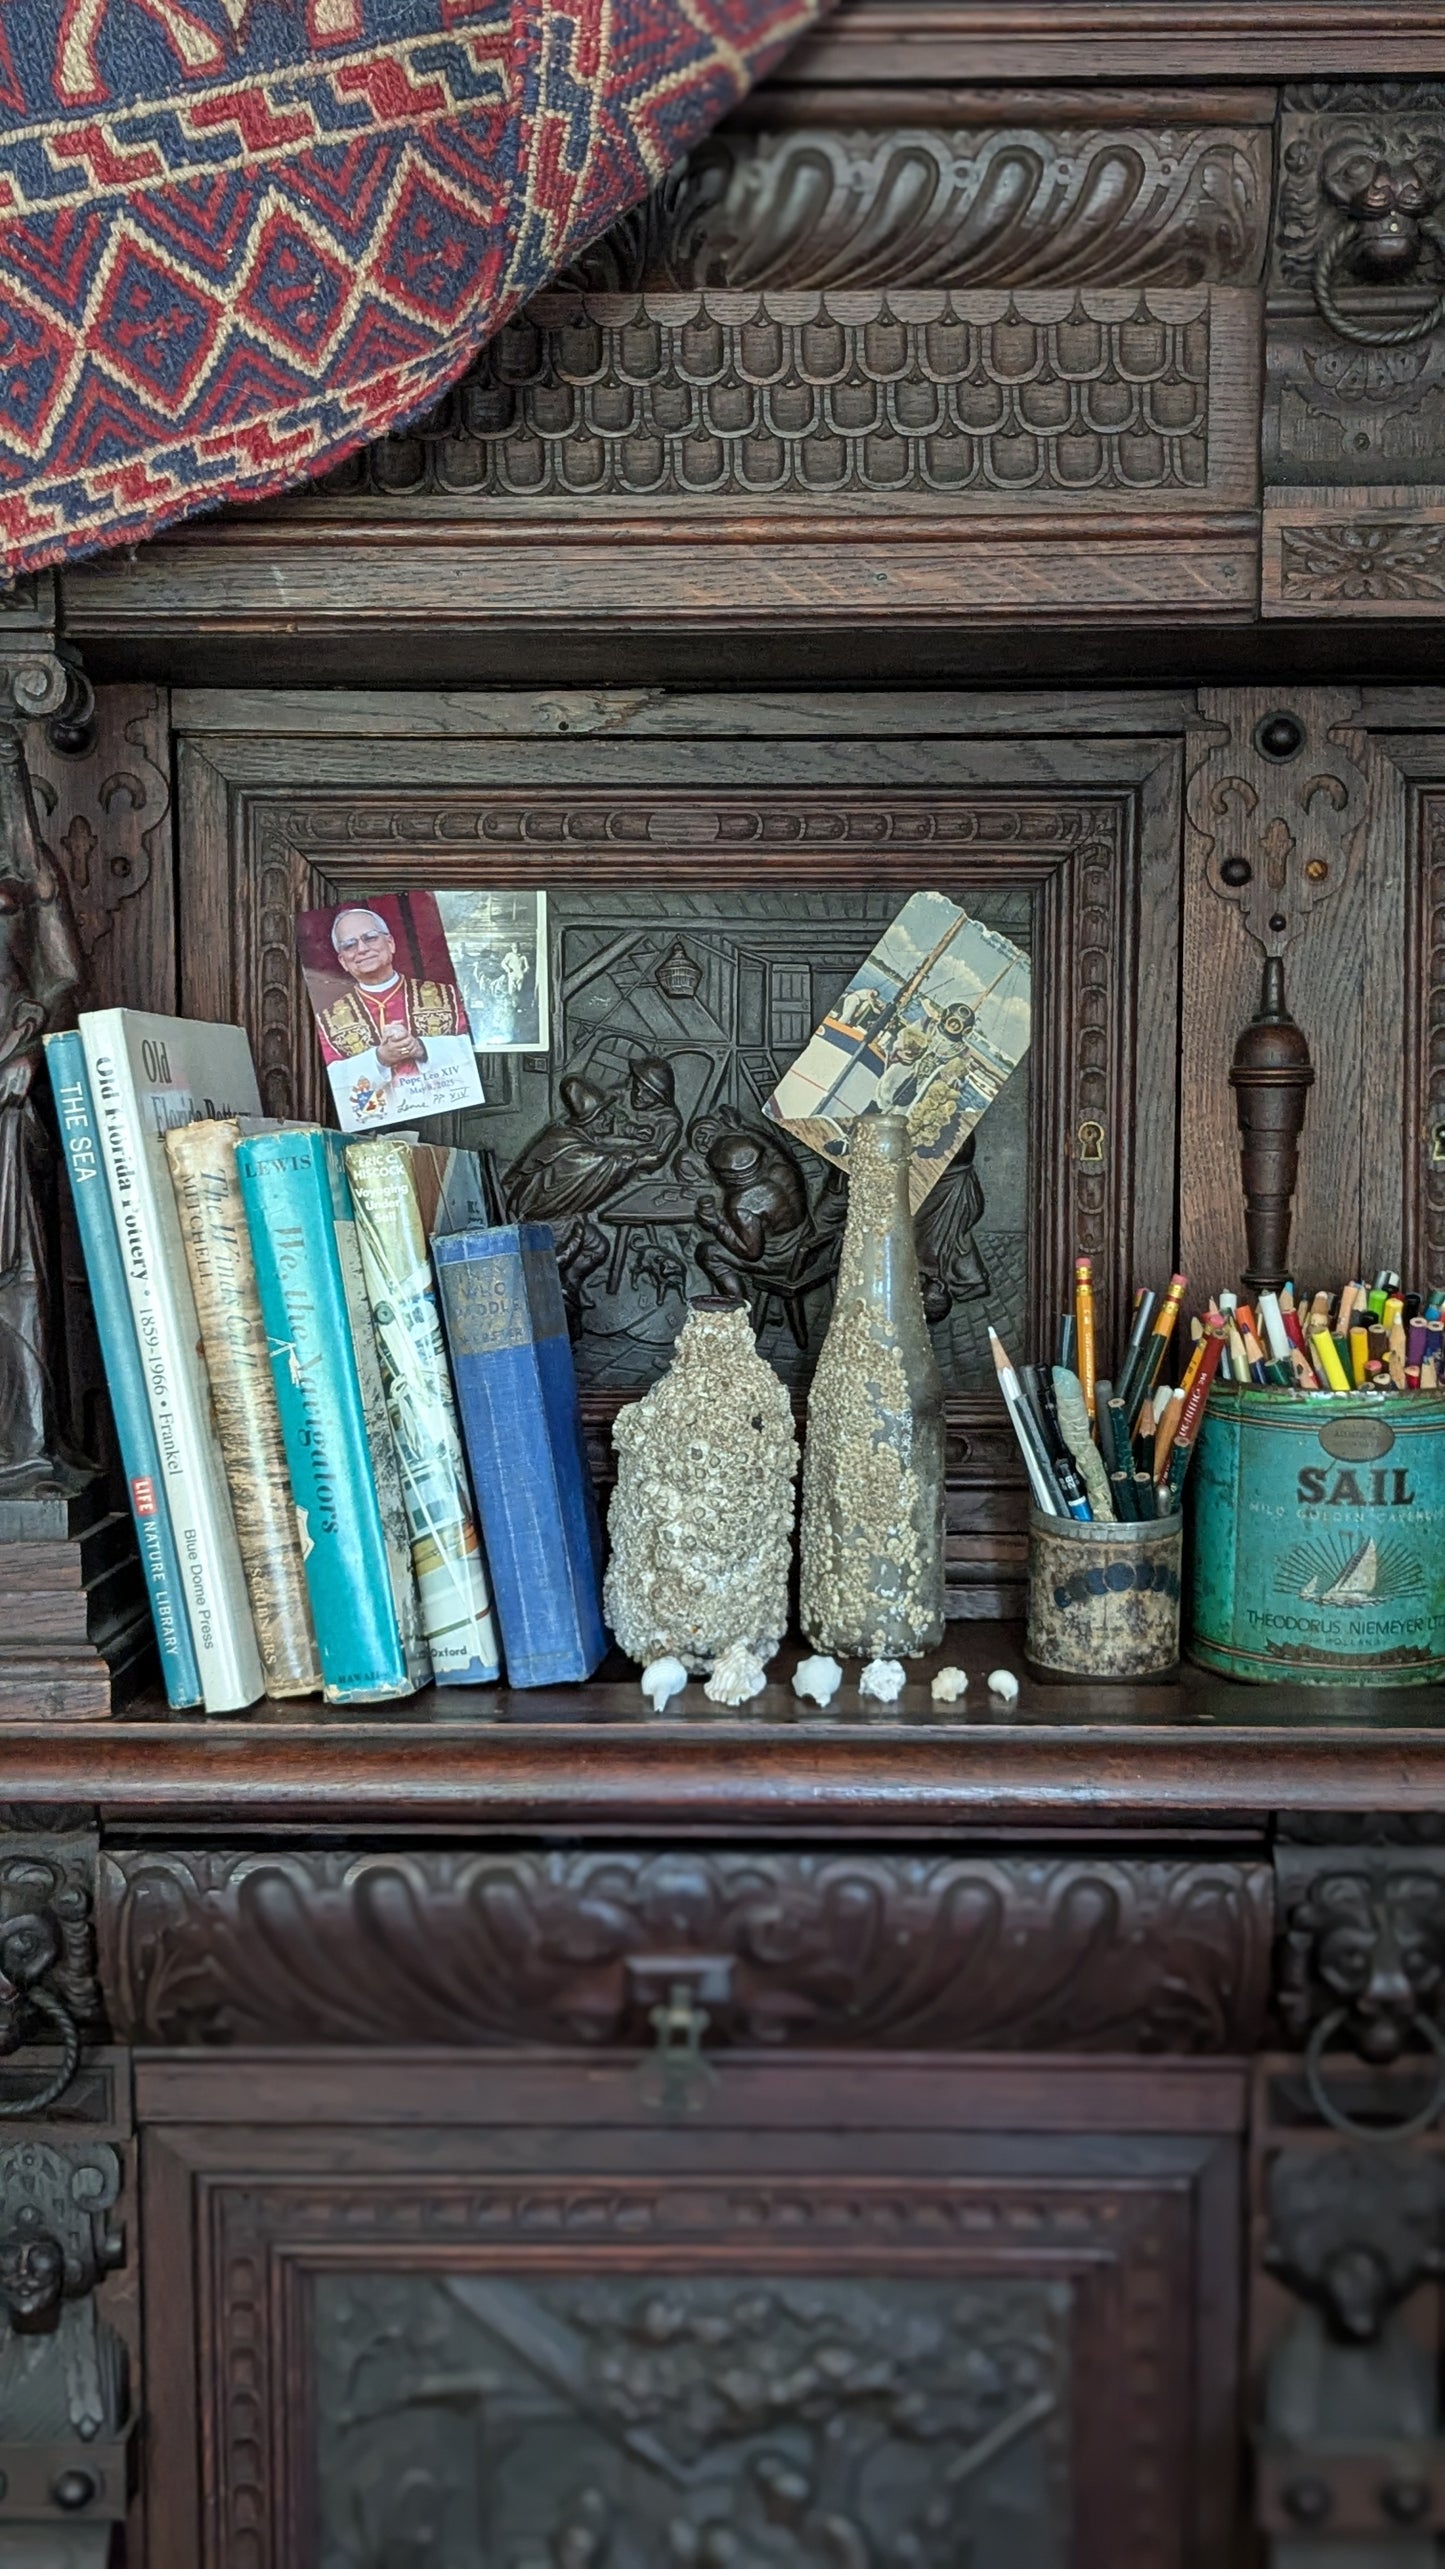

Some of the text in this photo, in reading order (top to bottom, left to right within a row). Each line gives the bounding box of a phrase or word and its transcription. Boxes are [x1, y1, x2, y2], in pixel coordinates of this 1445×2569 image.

[95, 1056, 120, 1100] Old
[141, 1039, 172, 1084] Old
[399, 1065, 460, 1087] Pope Leo XIV
[409, 1086, 426, 1095] May
[436, 1079, 455, 1089] 2025
[59, 1081, 97, 1183] THE SEA
[244, 1154, 313, 1178] LEWIS
[353, 1165, 407, 1181] HISCOCK
[358, 1155, 385, 1169] ERIC
[354, 1184, 409, 1199] Voyaging
[364, 1199, 401, 1211] Under
[182, 1174, 213, 1287] MITCHELL
[373, 1212, 397, 1224] Sail
[202, 1169, 230, 1215] The
[226, 1314, 259, 1369] Call
[284, 1290, 315, 1341] the
[139, 1308, 170, 1396] 1859-1966
[159, 1412, 183, 1476] Frankel
[1296, 1464, 1416, 1507] SAIL
[1296, 1508, 1366, 1523] GOLDEN
[184, 1528, 198, 1560] Blue
[133, 1479, 179, 1656] LIFE NATURE LIBRARY
[191, 1563, 206, 1606] Dome
[198, 1609, 214, 1650] Press
[250, 1567, 277, 1666] SCRIBNERS
[1247, 1609, 1341, 1633] THEODORUS
[1350, 1617, 1424, 1636] NIEMEYER
[430, 1644, 468, 1659] Oxford
